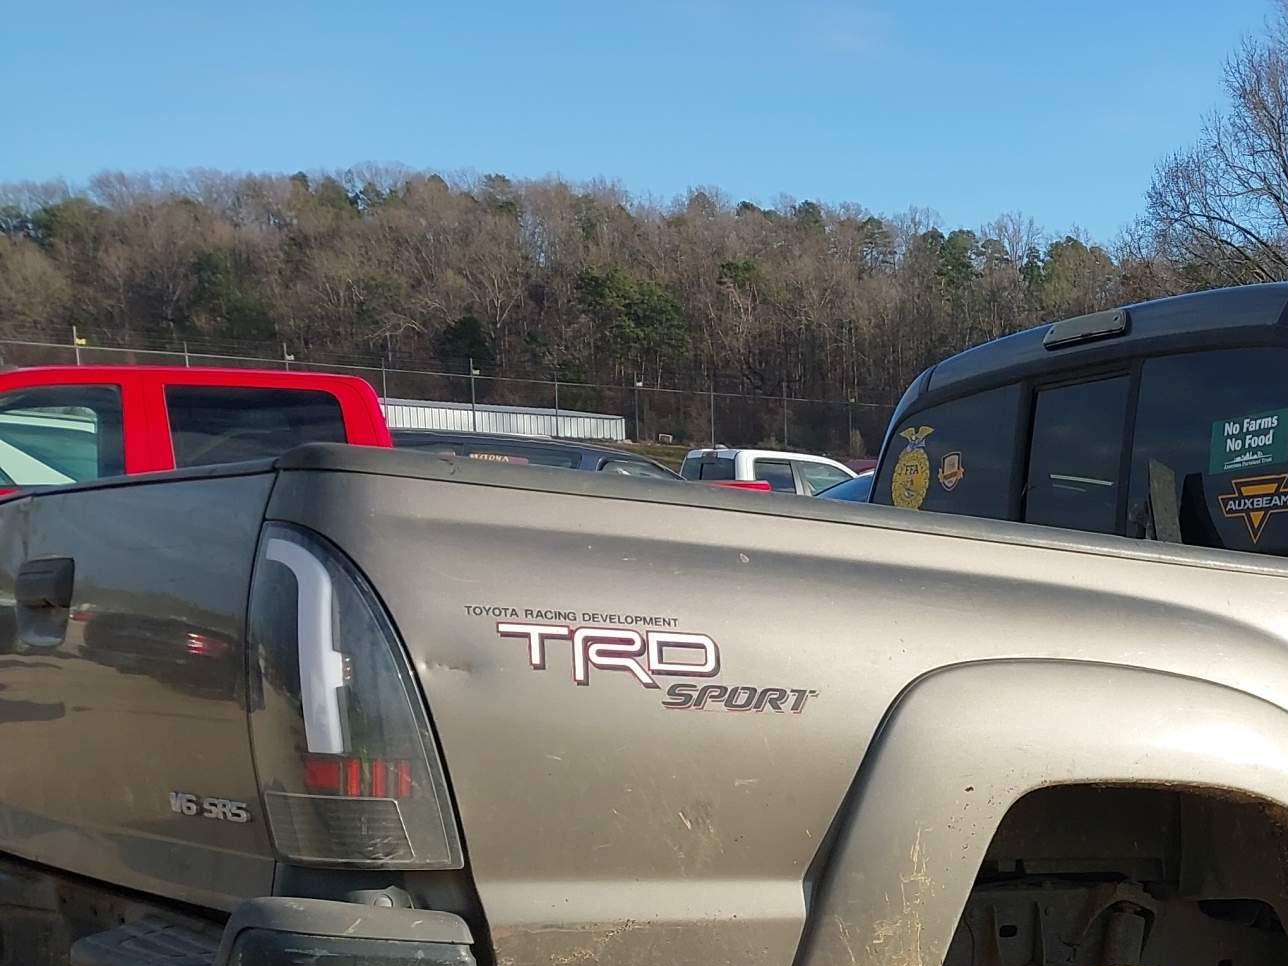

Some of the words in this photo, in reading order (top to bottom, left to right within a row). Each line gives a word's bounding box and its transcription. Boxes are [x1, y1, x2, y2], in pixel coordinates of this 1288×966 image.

[1223, 421, 1240, 436] No
[1243, 416, 1278, 432] Farms
[1226, 437, 1242, 453] No
[1245, 429, 1274, 448] Food
[463, 605, 519, 618] TOYOTA
[524, 608, 577, 622] RACING
[582, 611, 679, 628] DEVELOPMENT
[496, 621, 721, 690] TRD
[660, 683, 818, 714] SPORT
[168, 791, 198, 816] V6
[203, 797, 251, 823] SR5
